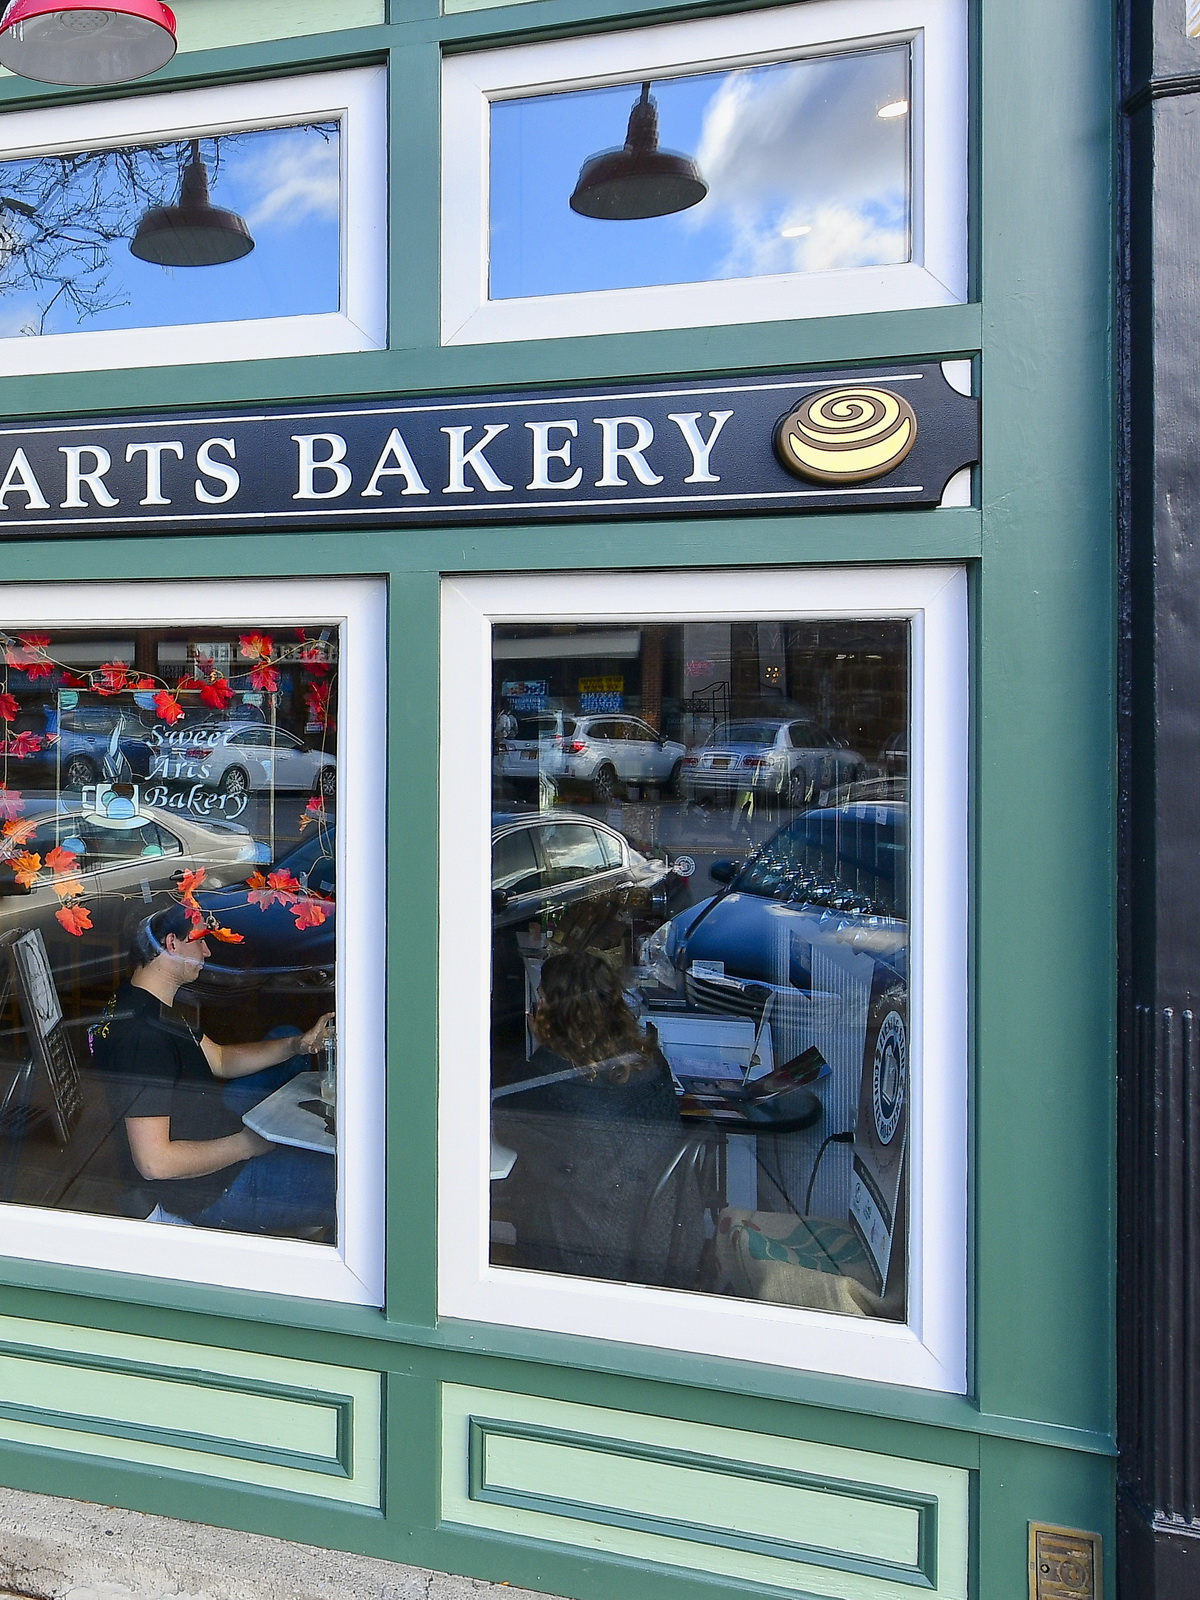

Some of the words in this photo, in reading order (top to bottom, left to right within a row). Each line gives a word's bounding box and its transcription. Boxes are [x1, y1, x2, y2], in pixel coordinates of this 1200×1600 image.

[291, 410, 734, 500] BAKERY
[145, 724, 234, 747] Sweet
[144, 754, 212, 780] Arts
[144, 784, 248, 820] Bakery
